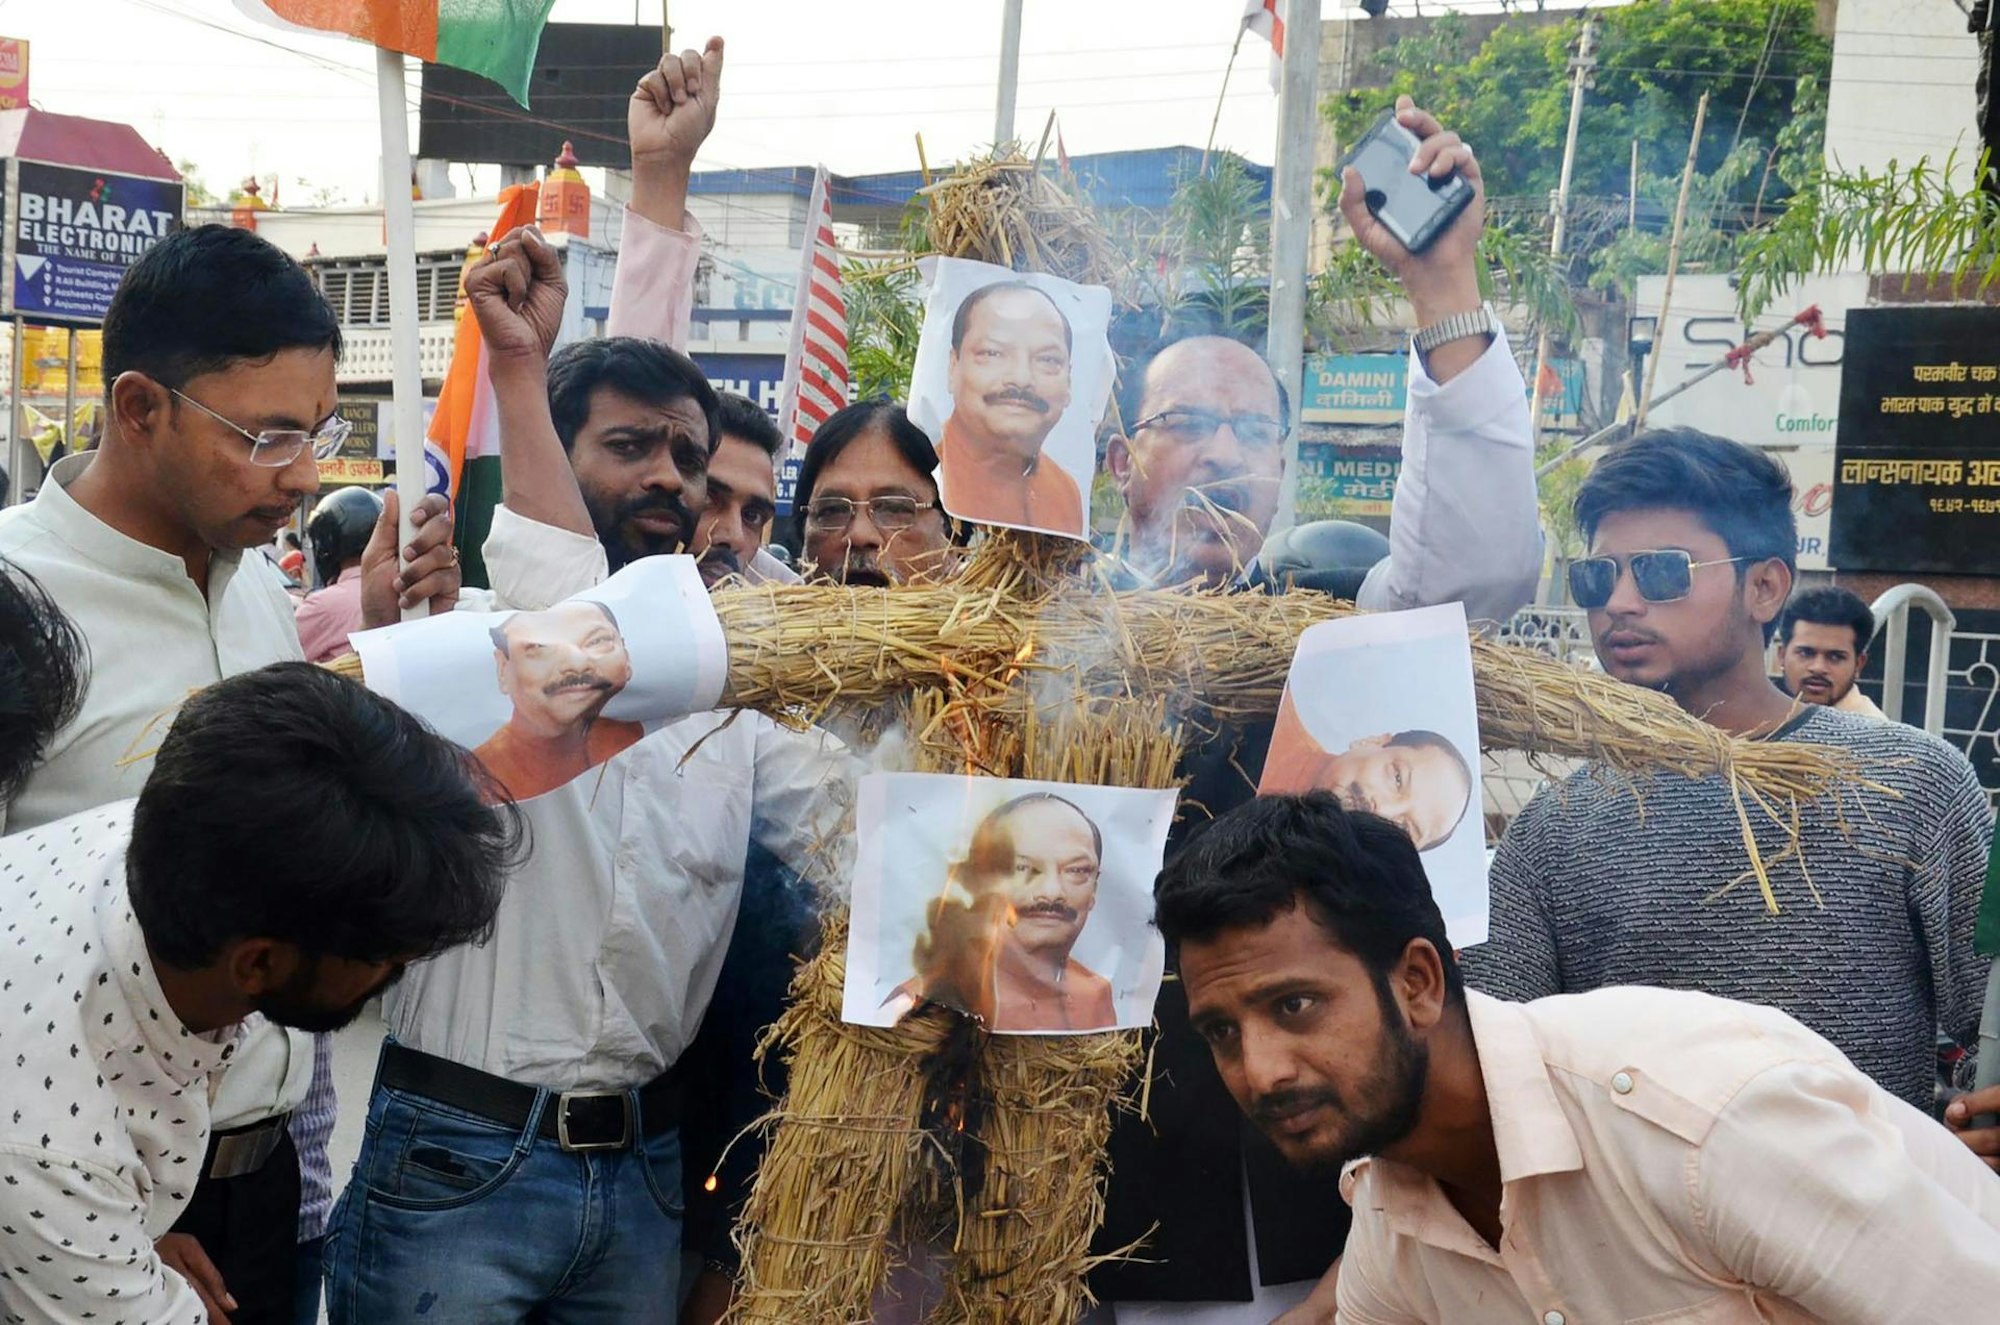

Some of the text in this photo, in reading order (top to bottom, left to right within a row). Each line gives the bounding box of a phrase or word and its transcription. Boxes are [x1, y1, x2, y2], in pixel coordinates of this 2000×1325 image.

[19, 192, 174, 237] BHARAT
[36, 243, 61, 255] THE
[64, 247, 97, 260] NAME
[101, 250, 116, 264] OF
[56, 264, 85, 276] Tourist
[1319, 371, 1396, 388] DAMINI
[1913, 361, 1997, 382] परमवीर चक्र
[1947, 396, 1975, 418] युद्ध
[1976, 393, 1994, 413] में
[1775, 412, 1838, 432] Comfor
